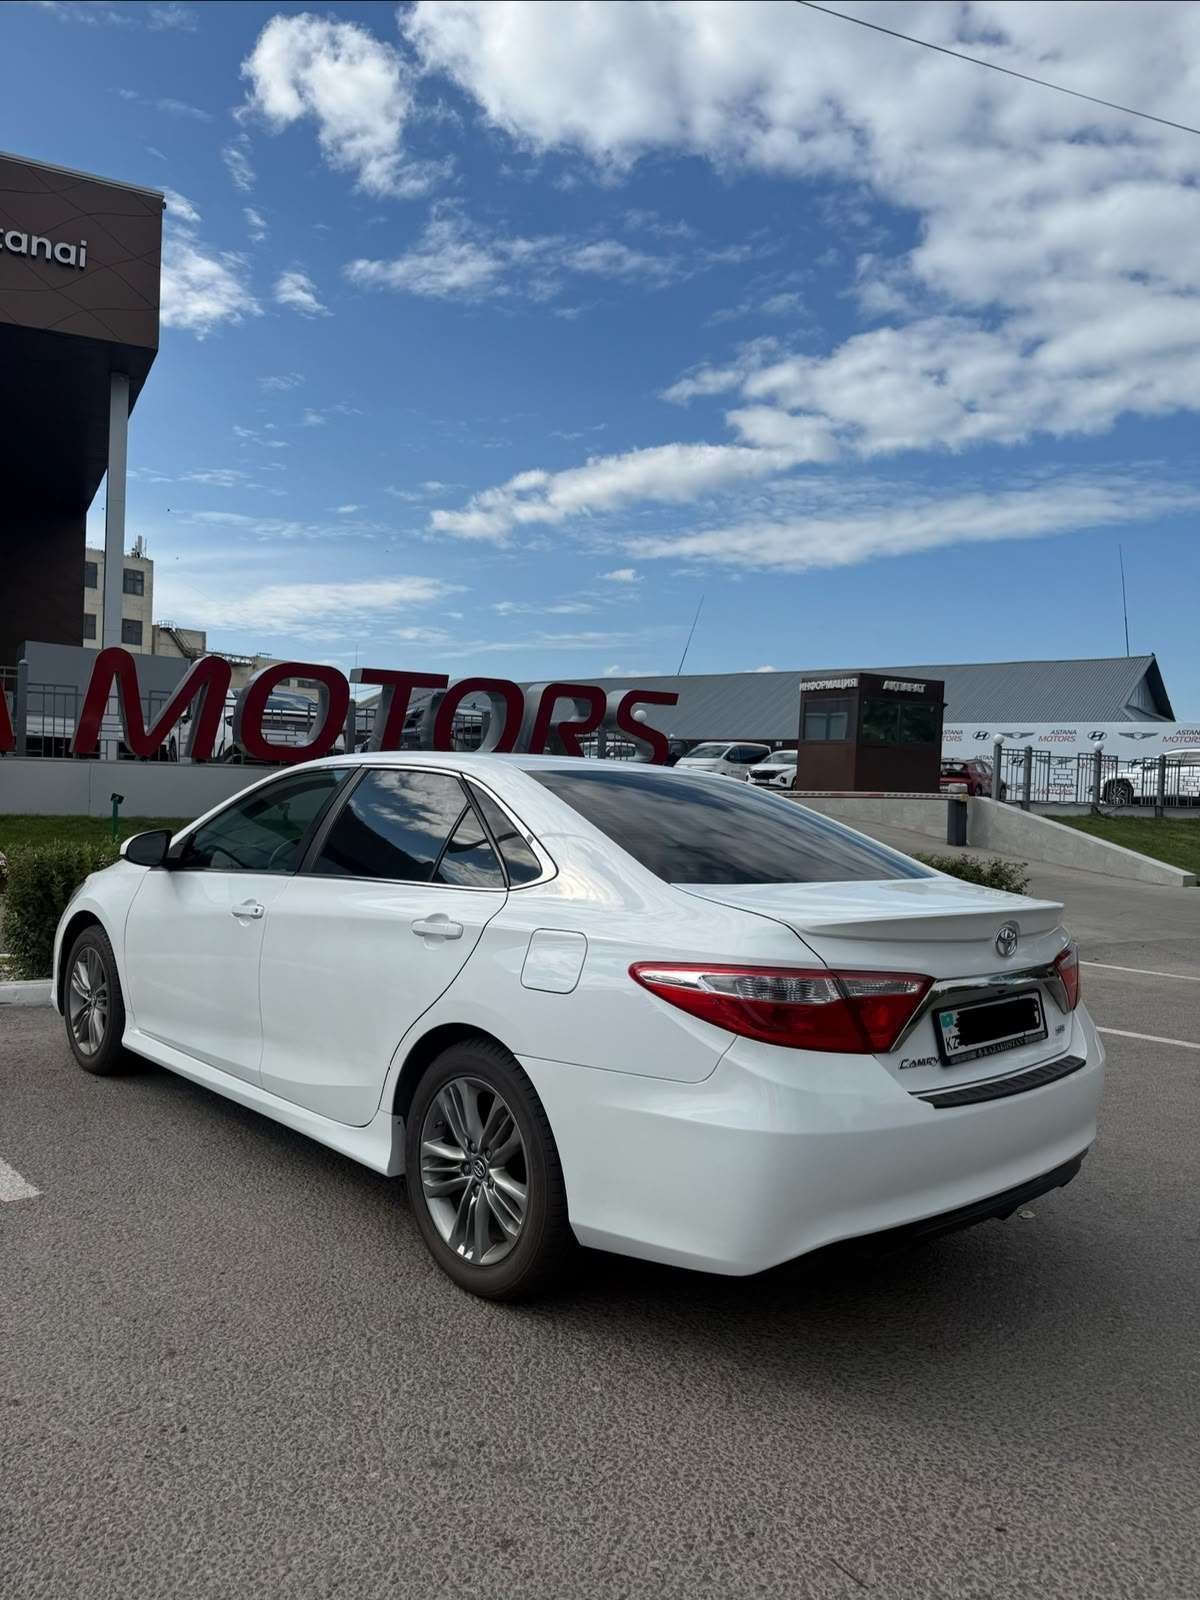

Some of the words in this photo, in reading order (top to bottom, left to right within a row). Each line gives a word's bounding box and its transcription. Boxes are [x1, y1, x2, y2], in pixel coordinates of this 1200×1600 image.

[799, 678, 859, 691] ИНФОРМАЦИЯ
[70, 646, 679, 766] MOTORS
[945, 1036, 960, 1051] KZ
[899, 1056, 940, 1070] CAMRY
